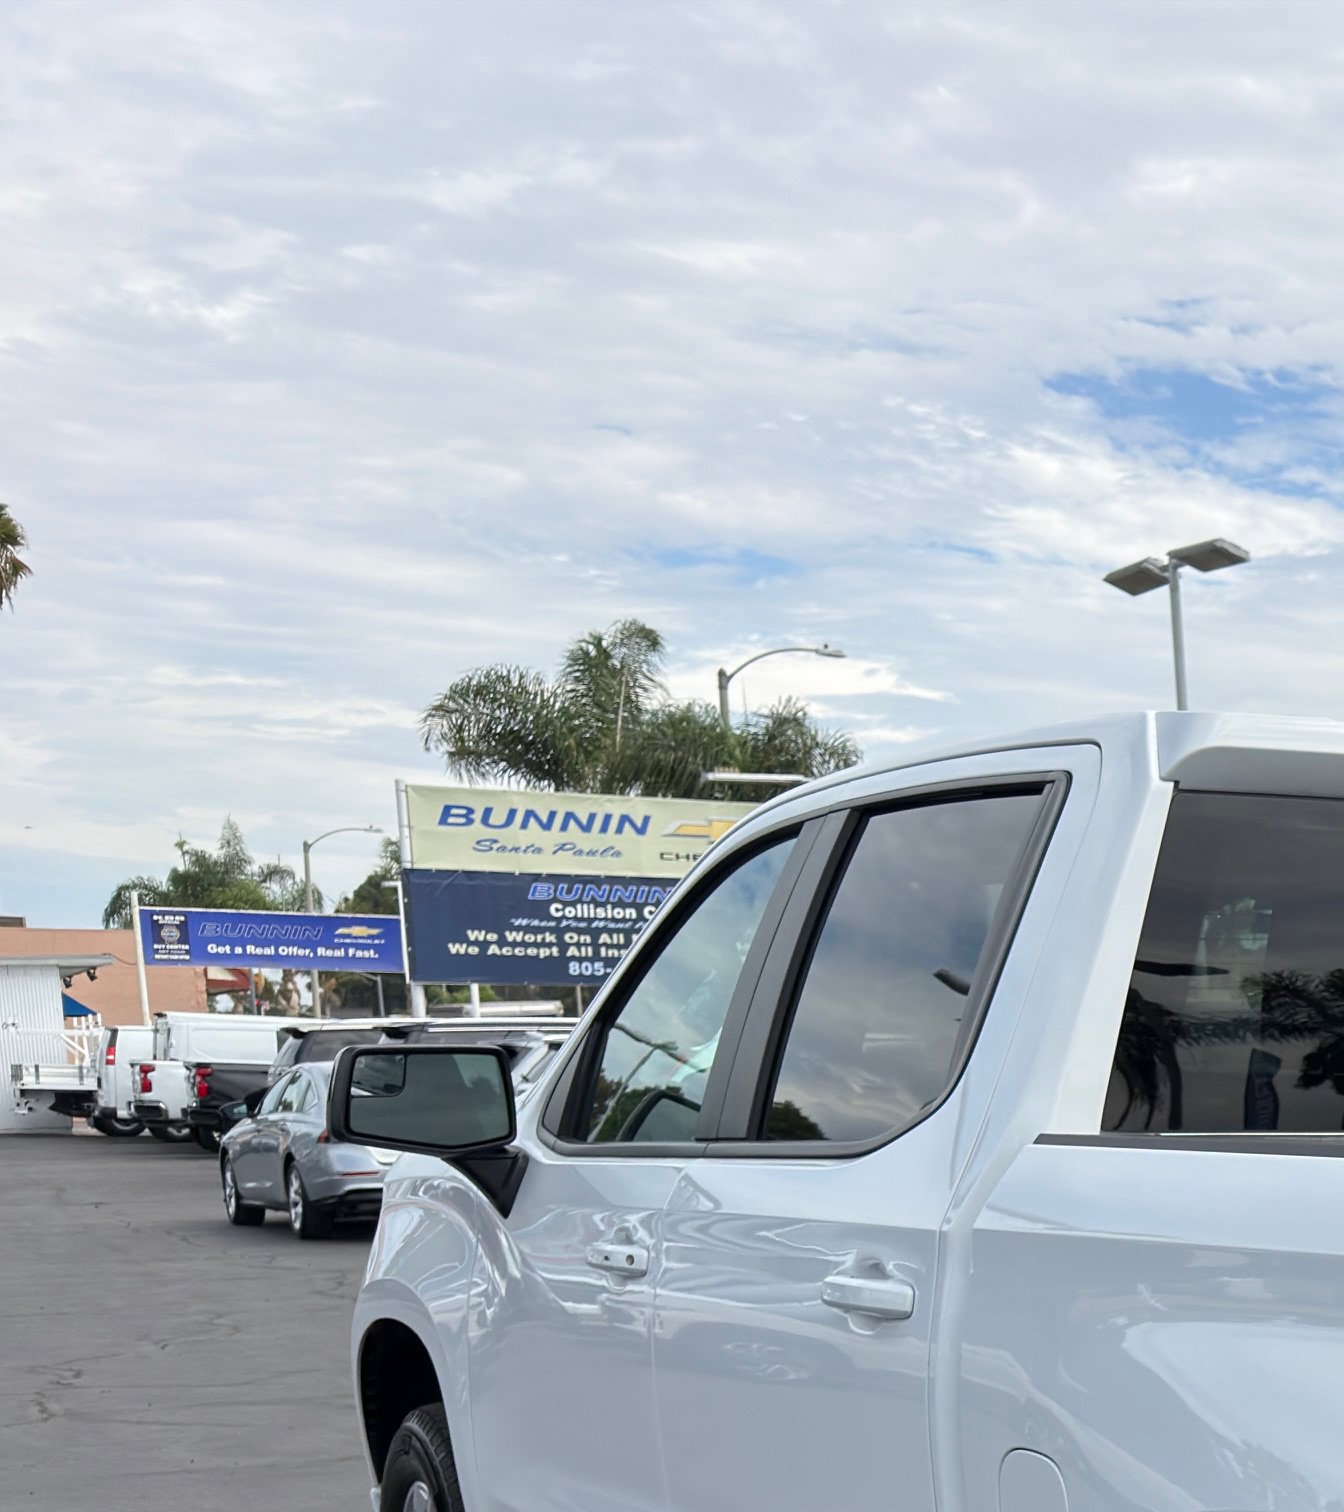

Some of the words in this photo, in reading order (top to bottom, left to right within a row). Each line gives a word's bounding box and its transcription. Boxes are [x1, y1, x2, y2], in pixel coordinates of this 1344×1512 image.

[437, 803, 651, 837] BUNNIN
[471, 837, 545, 856] Santa
[552, 841, 624, 859] Paula
[549, 902, 638, 920] Collision
[197, 921, 323, 941] BUNNIN
[466, 929, 498, 943] We
[504, 930, 557, 944] Work
[564, 931, 592, 945] On
[598, 933, 625, 945] All
[207, 943, 231, 955] Get
[234, 947, 243, 955] a
[246, 944, 275, 956] Real
[278, 945, 314, 958] Offer,
[317, 947, 345, 957] Real
[348, 947, 379, 960] Fast.
[447, 942, 480, 956] We
[486, 943, 560, 960] Accept
[566, 945, 593, 958] All
